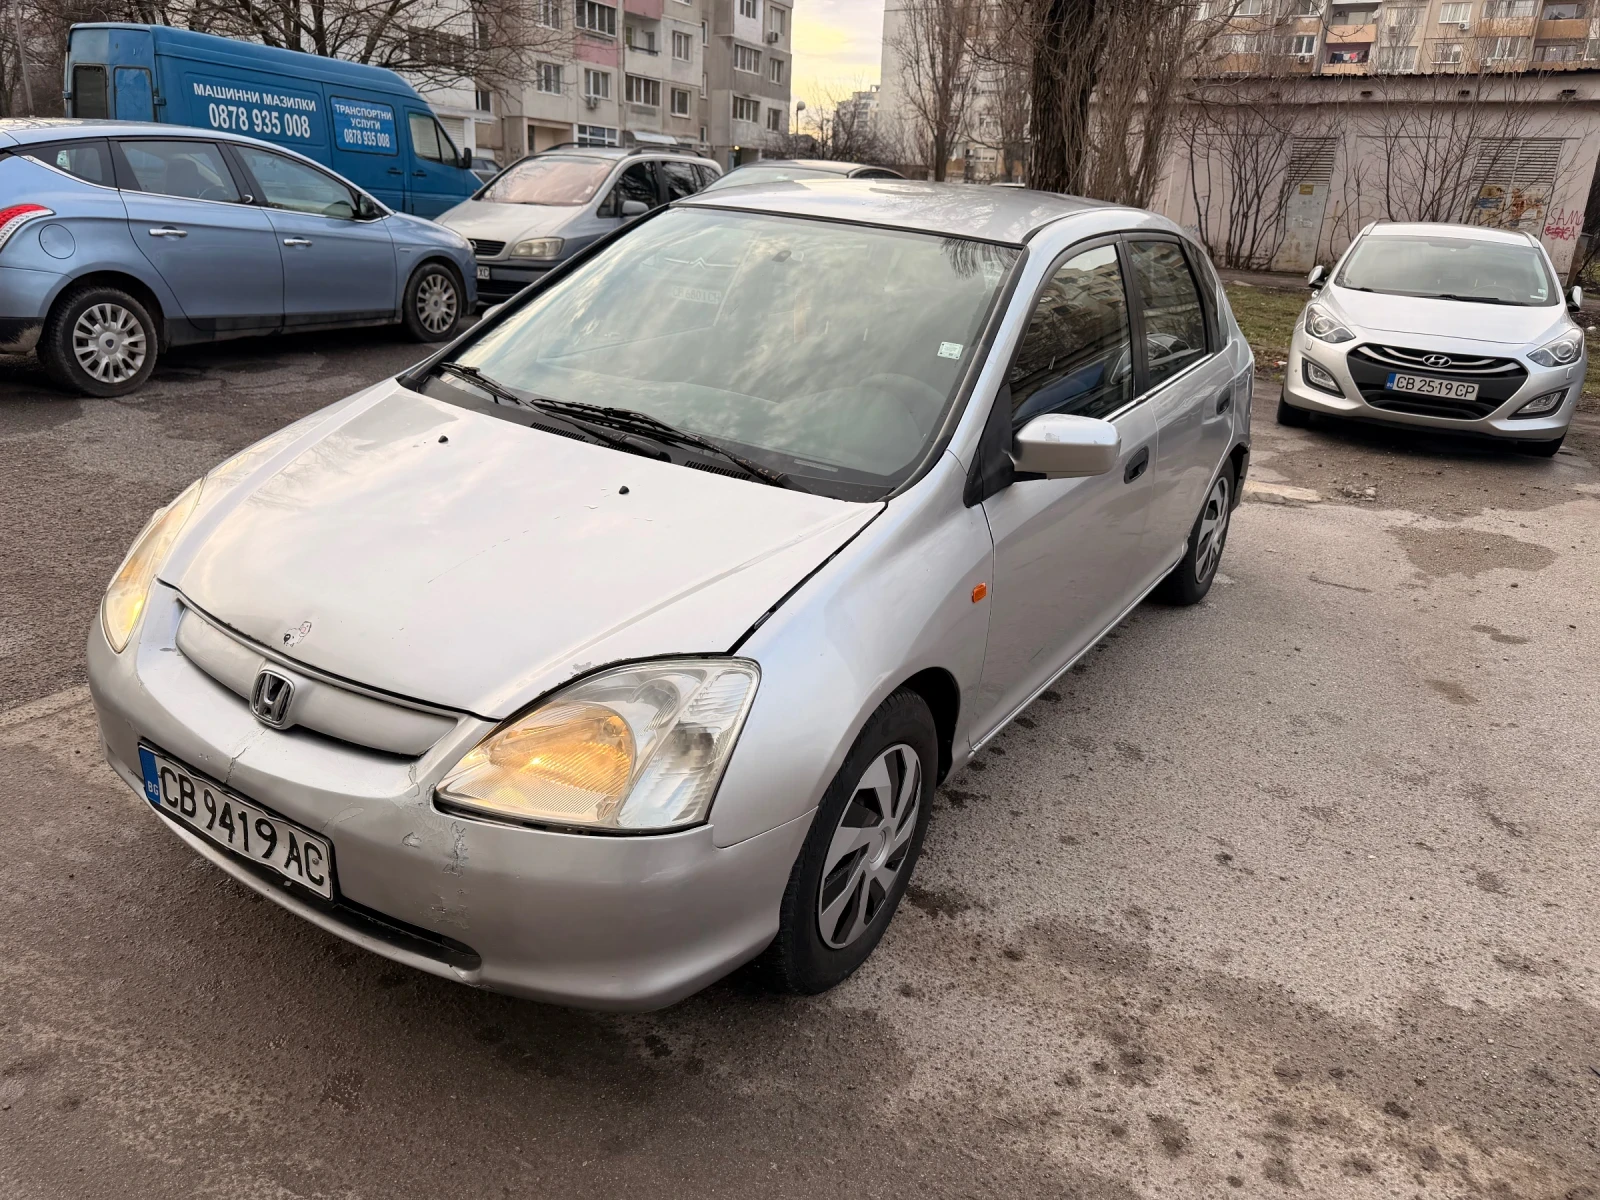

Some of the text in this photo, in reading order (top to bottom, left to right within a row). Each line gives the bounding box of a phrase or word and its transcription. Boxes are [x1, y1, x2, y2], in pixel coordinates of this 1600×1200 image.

[193, 83, 316, 112] МАШИННИ МАЗИЛКИ
[209, 103, 310, 138] 0878 935 008
[335, 104, 392, 120] ТРАНСПОРТНИ
[351, 118, 381, 130] УСЛУГИ
[344, 129, 390, 148] 0878 935 008
[1396, 376, 1415, 390] CB
[1417, 379, 1453, 395] 2519
[1455, 384, 1475, 397] CP
[148, 765, 325, 887] BG CB 9419 AC
